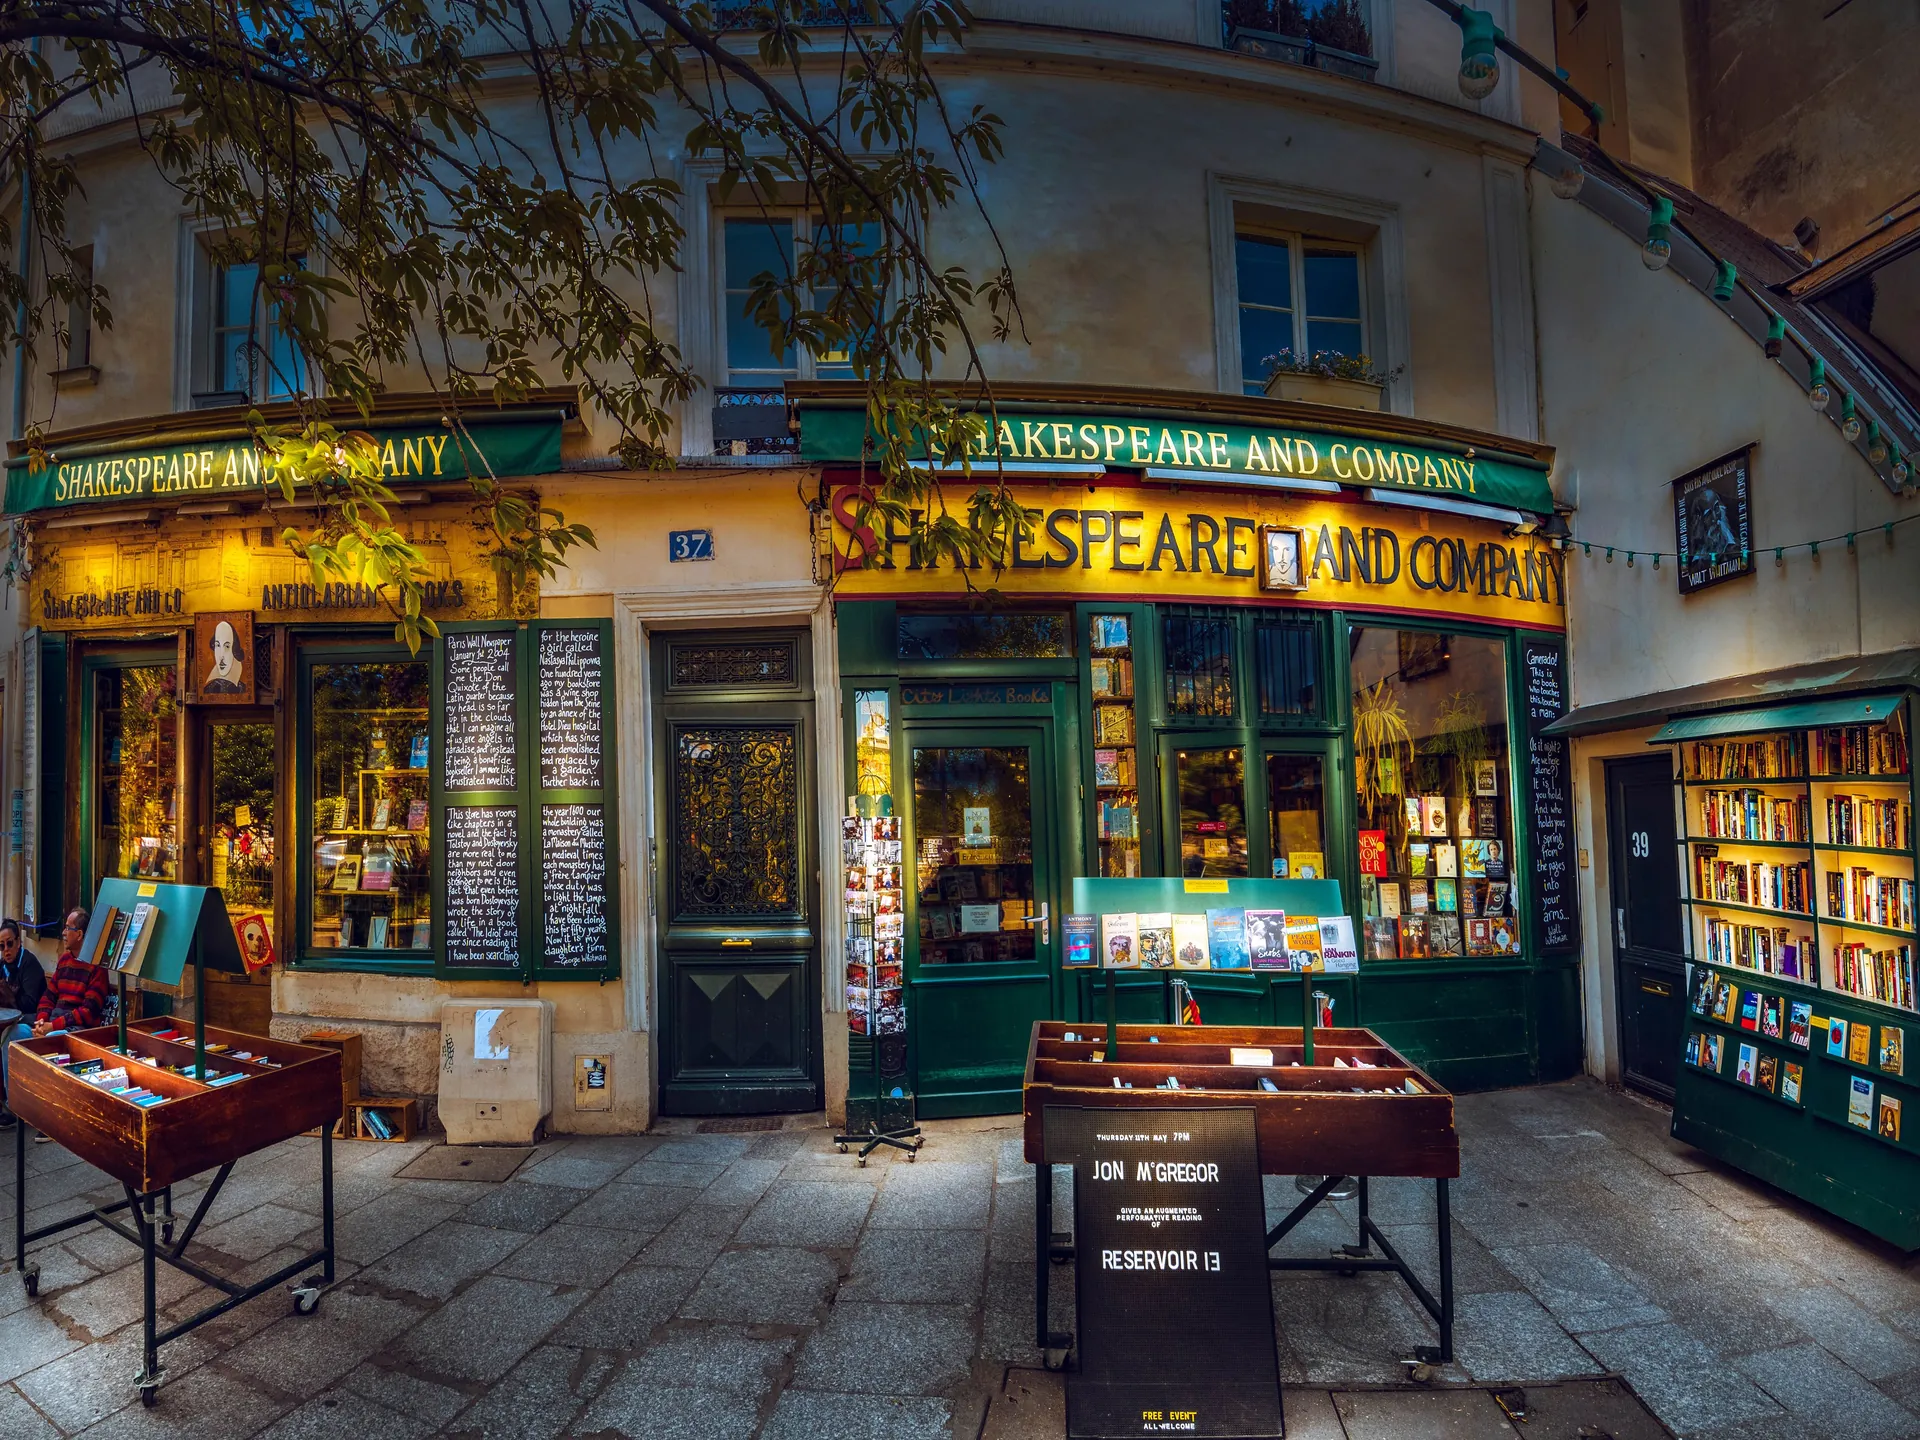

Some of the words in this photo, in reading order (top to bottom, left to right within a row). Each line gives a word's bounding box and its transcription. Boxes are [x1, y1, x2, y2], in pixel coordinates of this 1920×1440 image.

[1245, 435, 1319, 475] AND
[1330, 443, 1476, 494] COMPANY
[55, 450, 214, 501] SHAKESPEARE
[676, 533, 707, 558] 37
[831, 484, 1256, 577] SHESPEARE
[1311, 523, 1401, 584] AND
[1409, 536, 1565, 607] COMPANY
[1689, 569, 1707, 586] WALT
[1709, 557, 1740, 580] WHITMAN
[134, 590, 160, 615] AND
[448, 636, 466, 648] Paris
[467, 635, 480, 648] Wall
[541, 631, 553, 642] for
[556, 631, 570, 642] the
[570, 630, 599, 642] heroine
[450, 650, 475, 662] January
[487, 648, 510, 659] 2004
[1527, 649, 1558, 666] Camerado!
[450, 663, 470, 673] Some
[473, 665, 496, 676] people
[498, 662, 509, 672] call
[540, 669, 553, 678] One
[555, 666, 582, 678] hundred
[584, 671, 601, 681] years
[1530, 667, 1544, 677] This
[1547, 668, 1552, 677] is
[448, 682, 480, 693] Quixote
[482, 682, 489, 694] of
[492, 680, 507, 691] the
[1541, 686, 1559, 697] touches
[1531, 708, 1536, 717] a
[541, 721, 556, 731] Hotel
[558, 720, 571, 731] Dieu
[572, 718, 600, 733] hospital
[541, 734, 563, 743] which
[566, 734, 578, 743] has
[580, 734, 600, 743] since
[1538, 738, 1543, 751] it
[1531, 753, 1540, 765] Are
[1548, 756, 1560, 765] here
[1533, 777, 1539, 789] It
[1542, 778, 1549, 788] is
[1535, 792, 1546, 802] you
[447, 808, 463, 820] This
[465, 808, 480, 819] store
[481, 808, 493, 818] has
[495, 809, 516, 818] rooms
[543, 806, 554, 816] the
[555, 806, 568, 819] year
[587, 808, 601, 816] our
[1535, 801, 1548, 814] And
[1551, 802, 1562, 813] who
[543, 818, 559, 827] whole
[560, 816, 587, 830] building
[589, 818, 604, 827] was
[1538, 815, 1553, 828] holds
[1359, 837, 1379, 847] NEW
[1543, 833, 1564, 850] spring
[1632, 832, 1649, 857] 39
[1542, 844, 1558, 860] from
[448, 859, 463, 868] than
[466, 860, 475, 870] my
[478, 858, 493, 867] next
[496, 858, 515, 867] door
[1537, 859, 1547, 872] the
[1549, 861, 1565, 877] pages
[1544, 877, 1559, 891] into
[1542, 895, 1560, 911] your
[587, 943, 607, 952] turn.
[453, 950, 468, 960] have
[469, 949, 485, 960] been
[486, 950, 519, 967] searching
[561, 955, 580, 966] George
[1096, 1134, 1133, 1142] THURSDAY
[1153, 1134, 1168, 1143] MAY
[1173, 1132, 1190, 1142] 7PM
[1093, 1161, 1124, 1181] JON
[1102, 1250, 1198, 1270] RESERVOIR
[1142, 1412, 1163, 1420] FREE
[1170, 1412, 1197, 1423] EVENT
